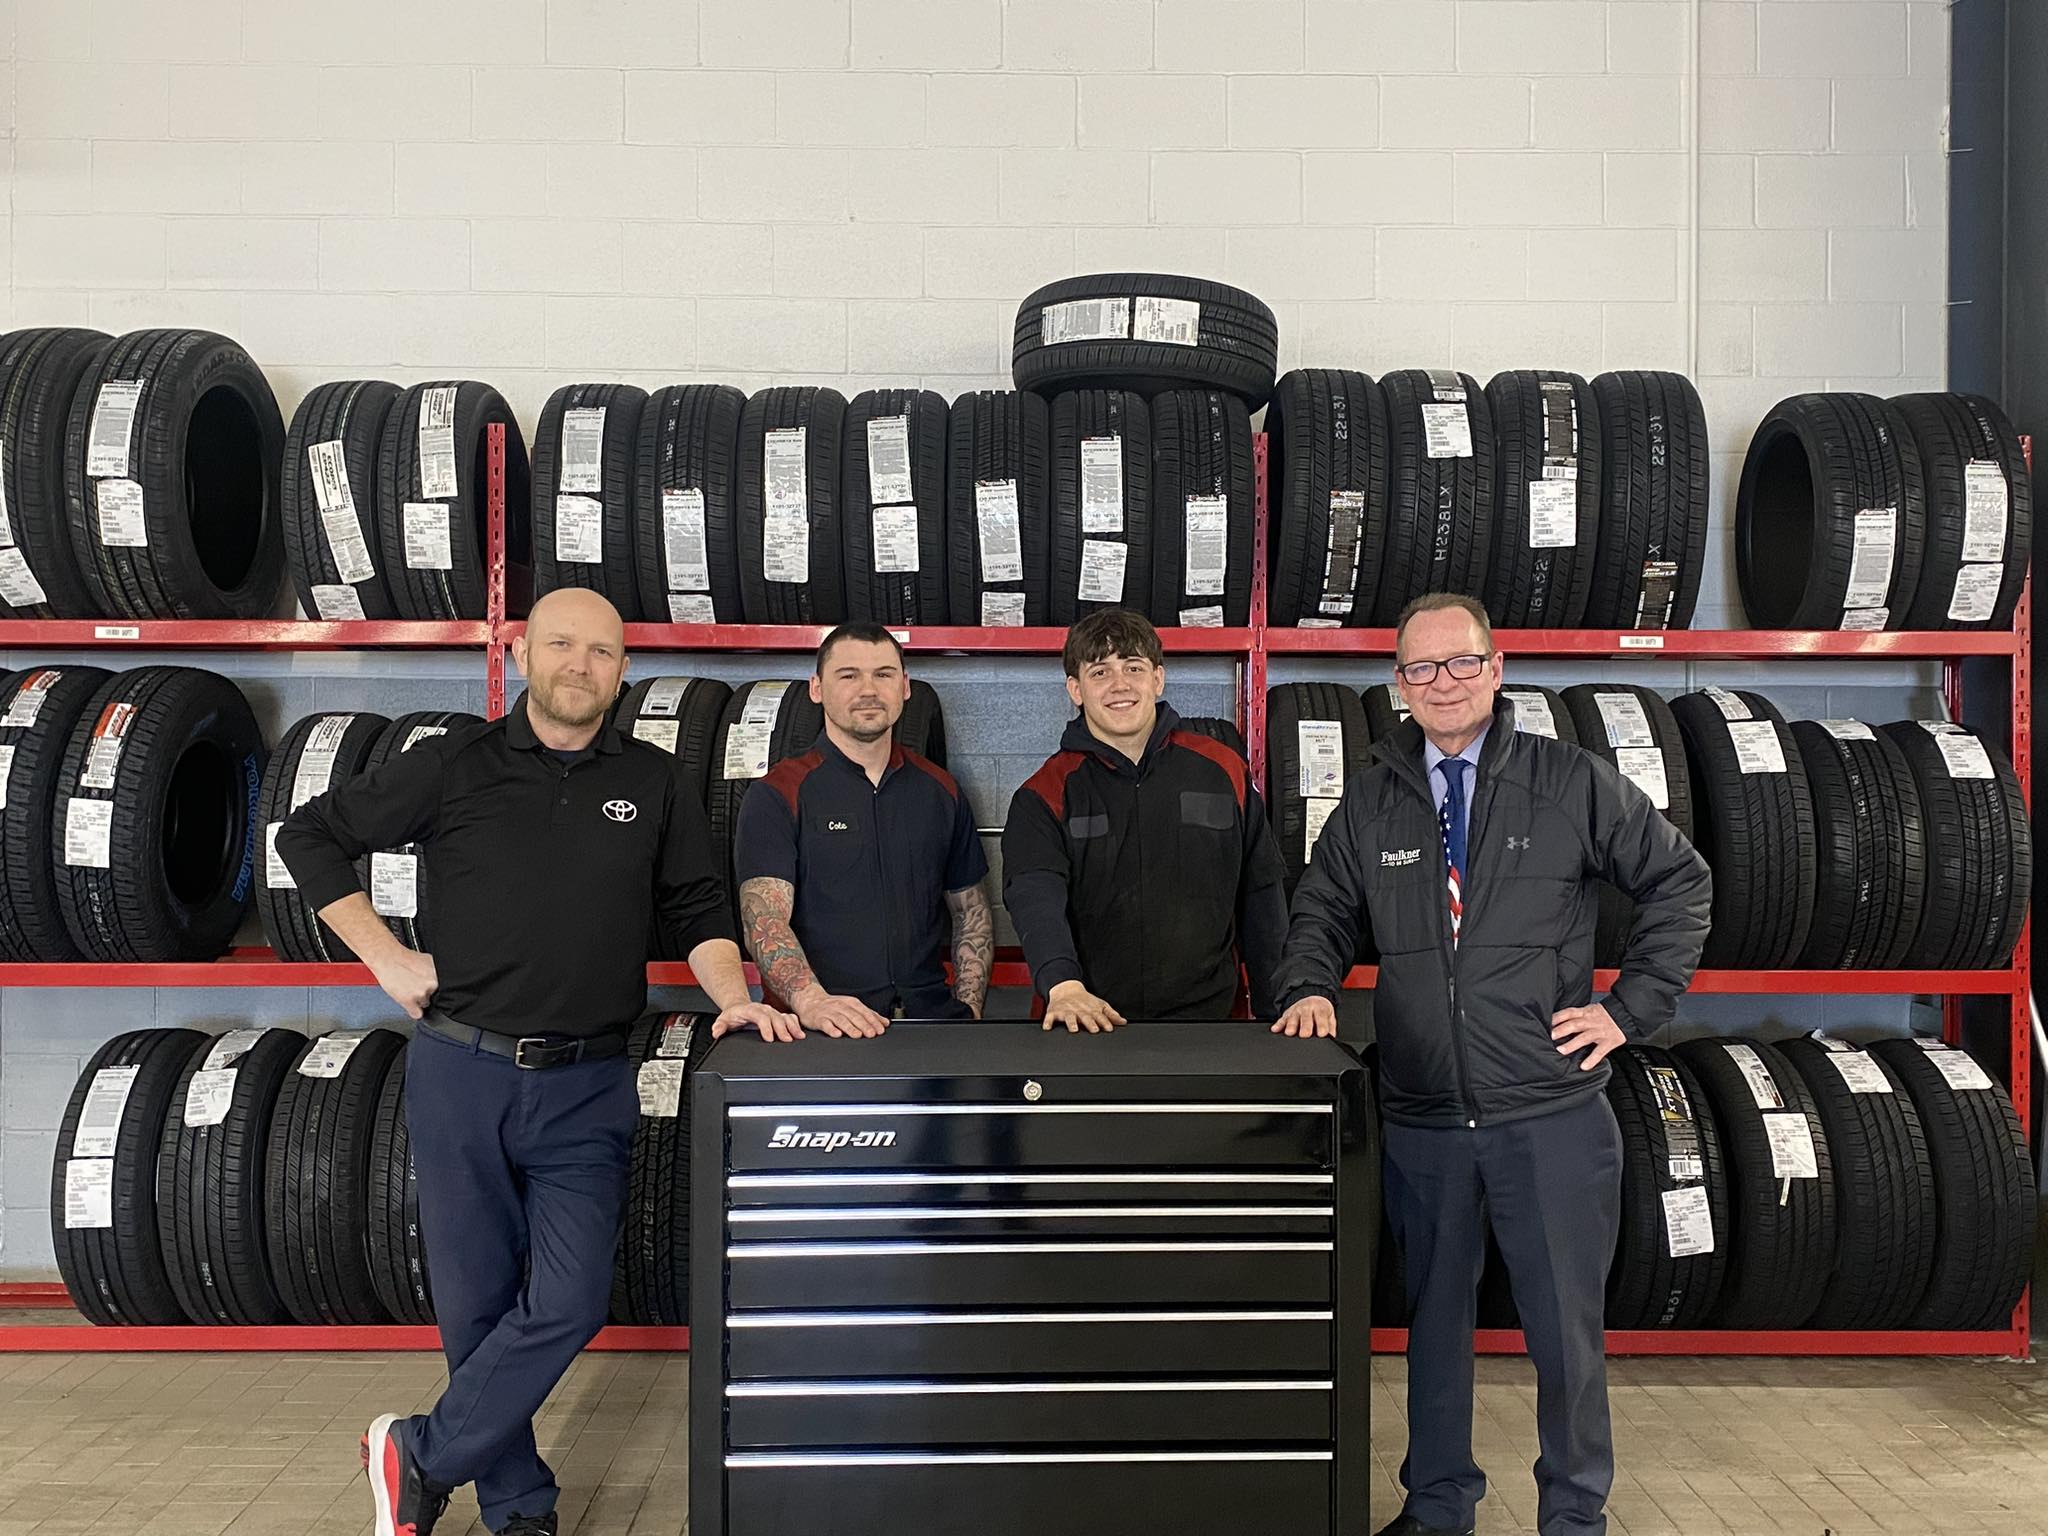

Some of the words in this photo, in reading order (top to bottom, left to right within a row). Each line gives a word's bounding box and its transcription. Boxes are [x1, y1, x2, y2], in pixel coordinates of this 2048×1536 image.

[828, 820, 848, 831] Cole
[1380, 849, 1421, 863] Faulkner
[767, 1125, 896, 1152] Snap-on
